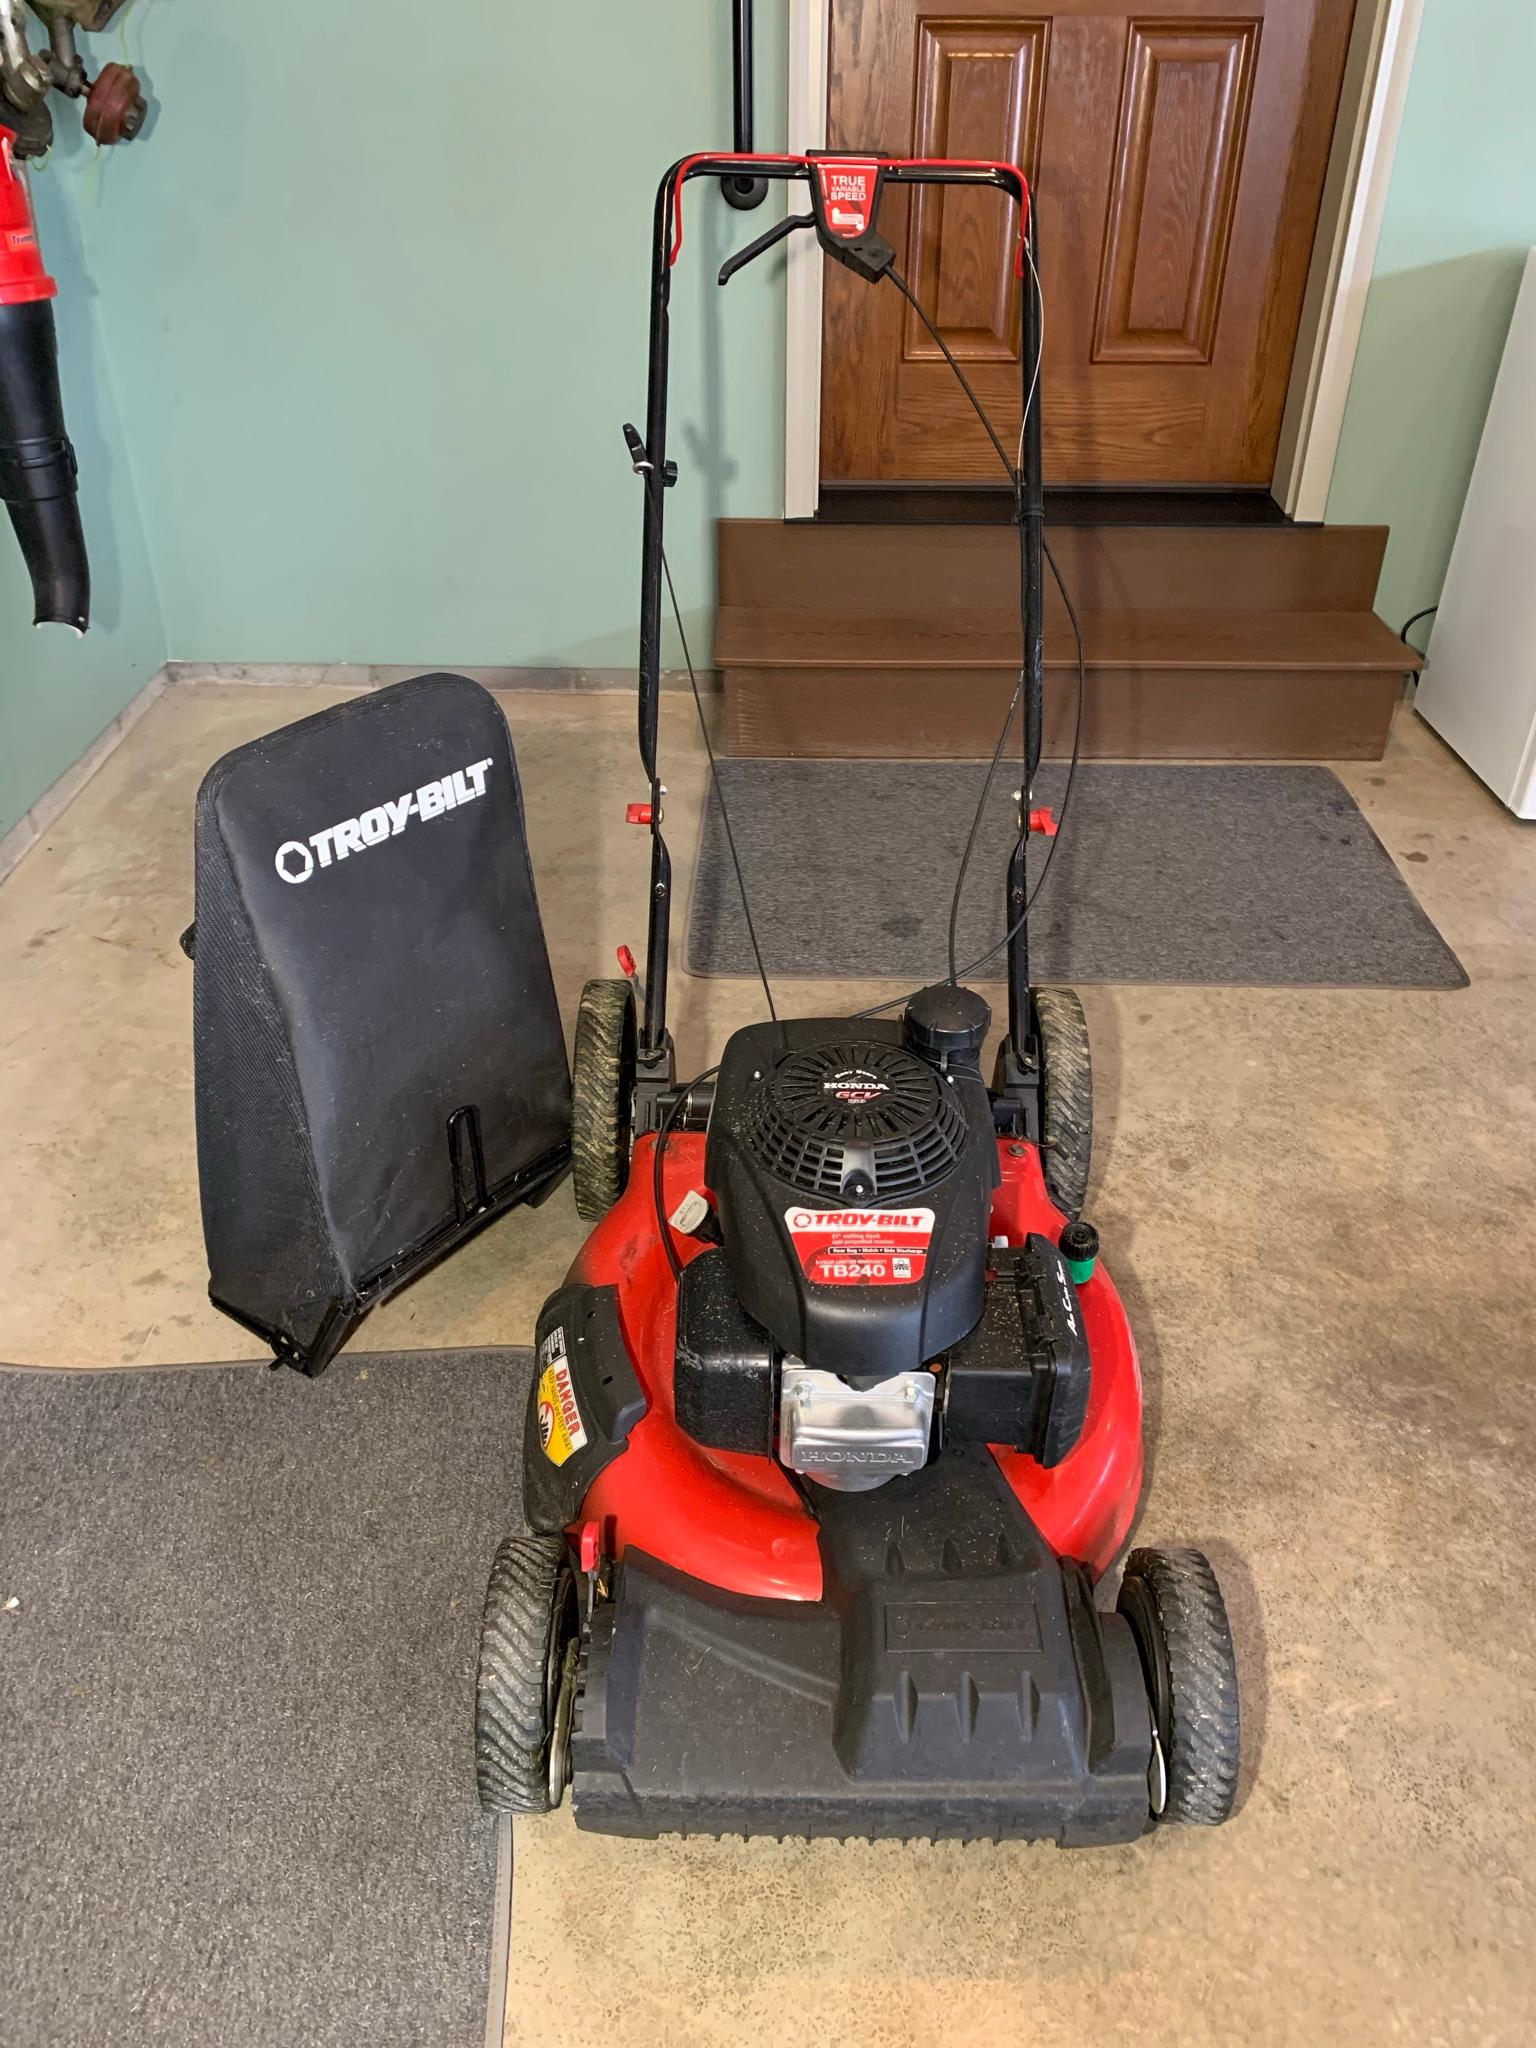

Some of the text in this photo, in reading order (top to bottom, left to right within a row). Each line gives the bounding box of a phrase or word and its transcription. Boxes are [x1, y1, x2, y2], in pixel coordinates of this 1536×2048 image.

[831, 176, 866, 186] TRUE
[830, 192, 867, 201] SPEED
[835, 1091, 882, 1099] GCV
[815, 1213, 924, 1228] TROY-BILT
[819, 1264, 886, 1278] TB240
[556, 1368, 580, 1437] DANGER
[800, 1451, 915, 1464] HONDA
